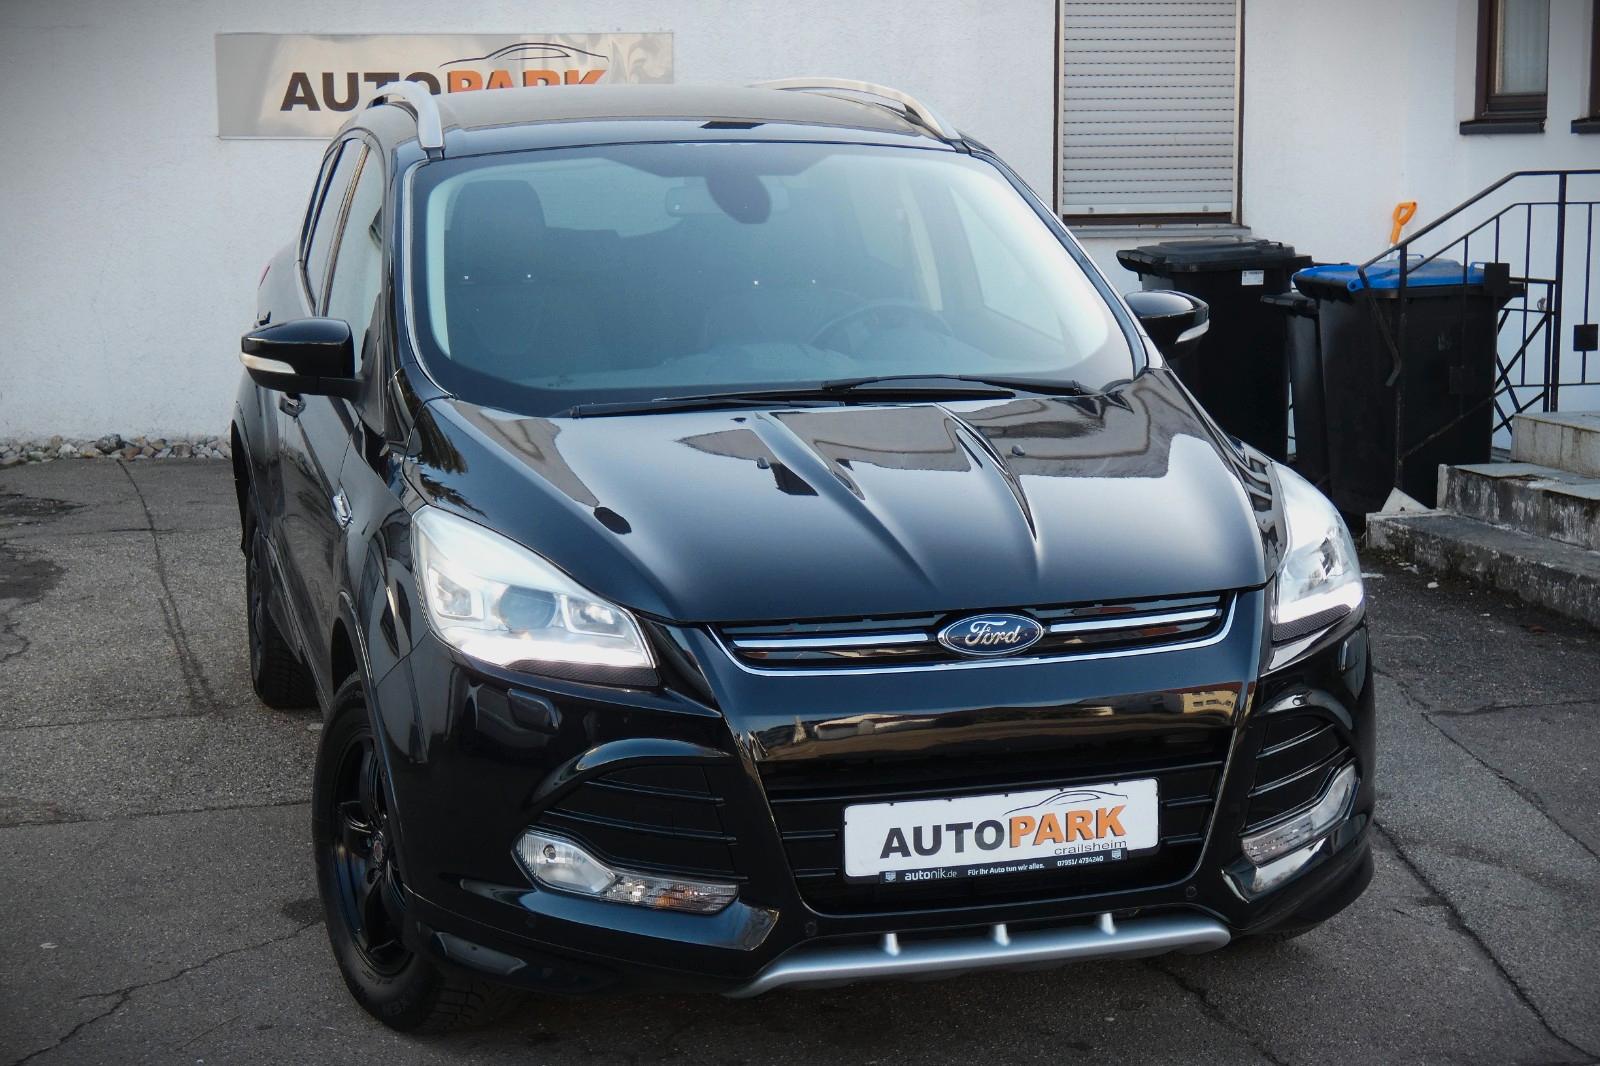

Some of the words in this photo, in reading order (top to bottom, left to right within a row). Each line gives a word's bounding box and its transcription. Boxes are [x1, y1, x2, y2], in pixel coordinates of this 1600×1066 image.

[965, 620, 1022, 647] Ford
[879, 804, 1128, 860] AUTOPARK
[1053, 839, 1128, 856] crailsheim
[904, 868, 958, 881] autonik.de
[989, 866, 1005, 874] Auto
